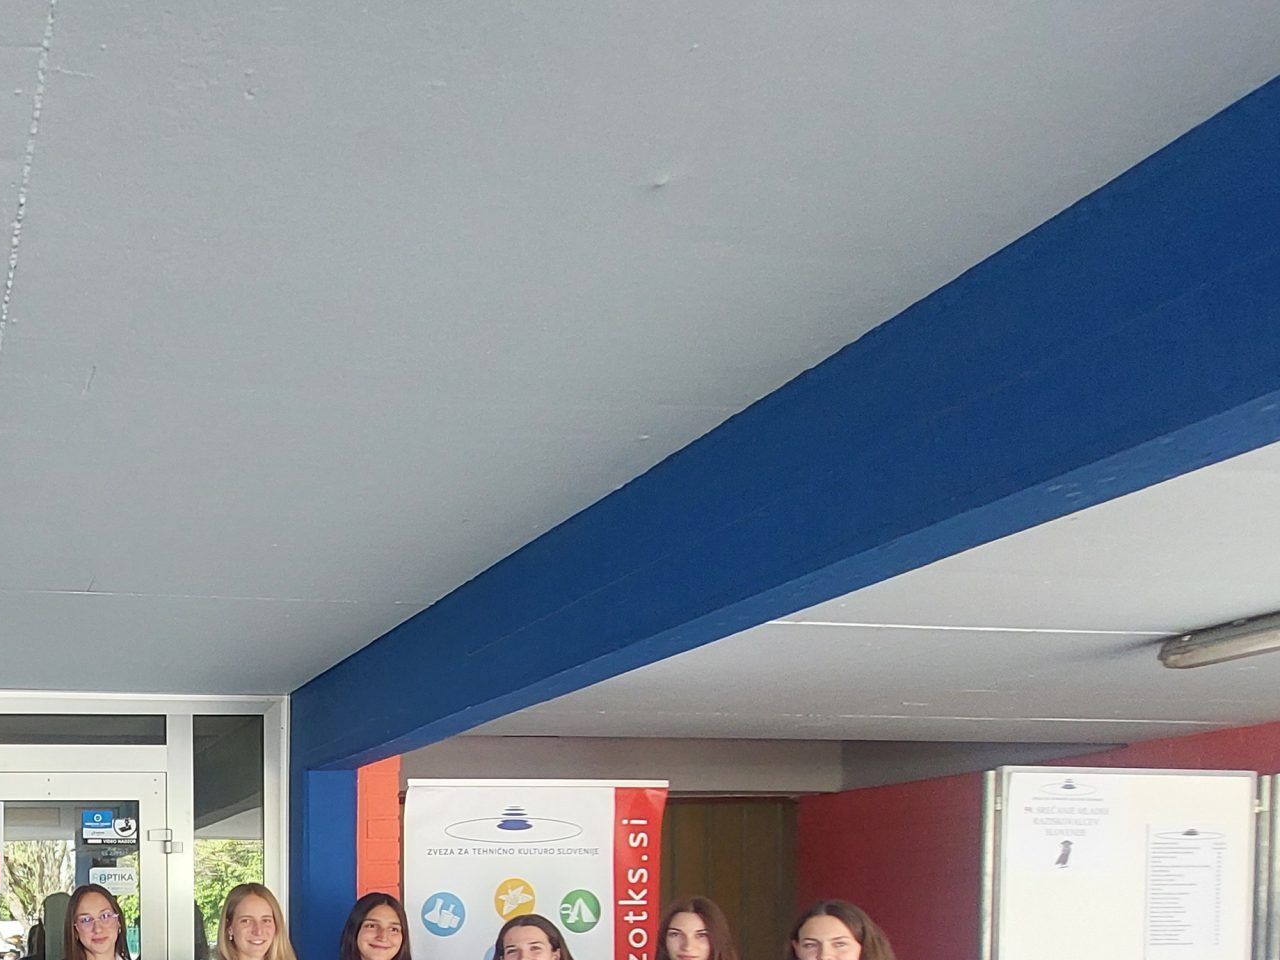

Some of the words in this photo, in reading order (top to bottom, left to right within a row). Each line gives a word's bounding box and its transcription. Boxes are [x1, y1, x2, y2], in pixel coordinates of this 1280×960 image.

[427, 848, 455, 856] ZVEZA
[458, 848, 470, 856] ZA
[472, 847, 515, 856] TEHNIČNO
[517, 848, 555, 856] KULTURO
[557, 848, 599, 856] SLOVENIJE
